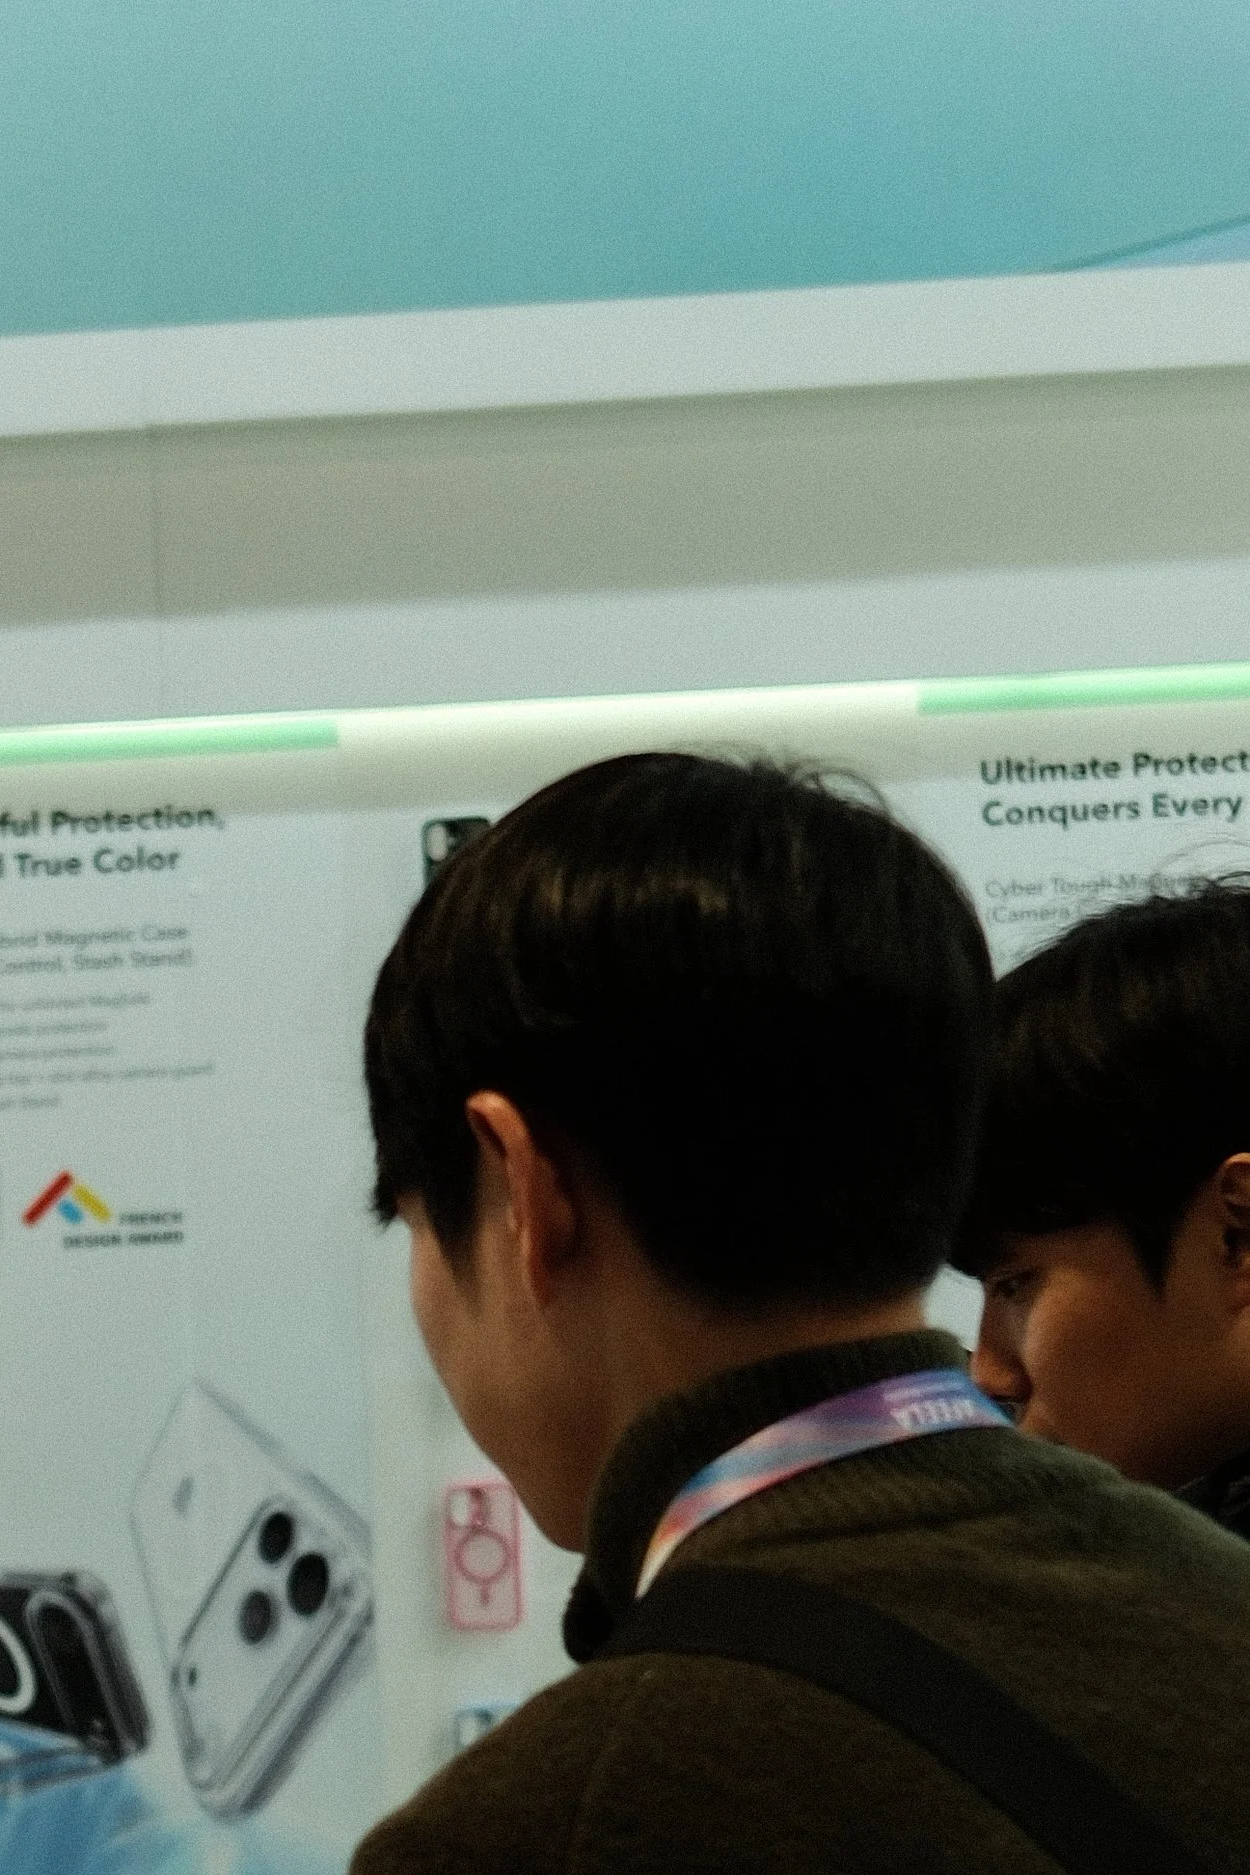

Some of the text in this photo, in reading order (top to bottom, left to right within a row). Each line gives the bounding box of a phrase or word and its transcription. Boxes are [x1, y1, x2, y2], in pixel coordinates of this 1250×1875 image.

[980, 756, 1122, 785] Ultimate
[981, 792, 1243, 831] Conquers Every
[15, 851, 82, 877] True
[93, 844, 180, 874] Color
